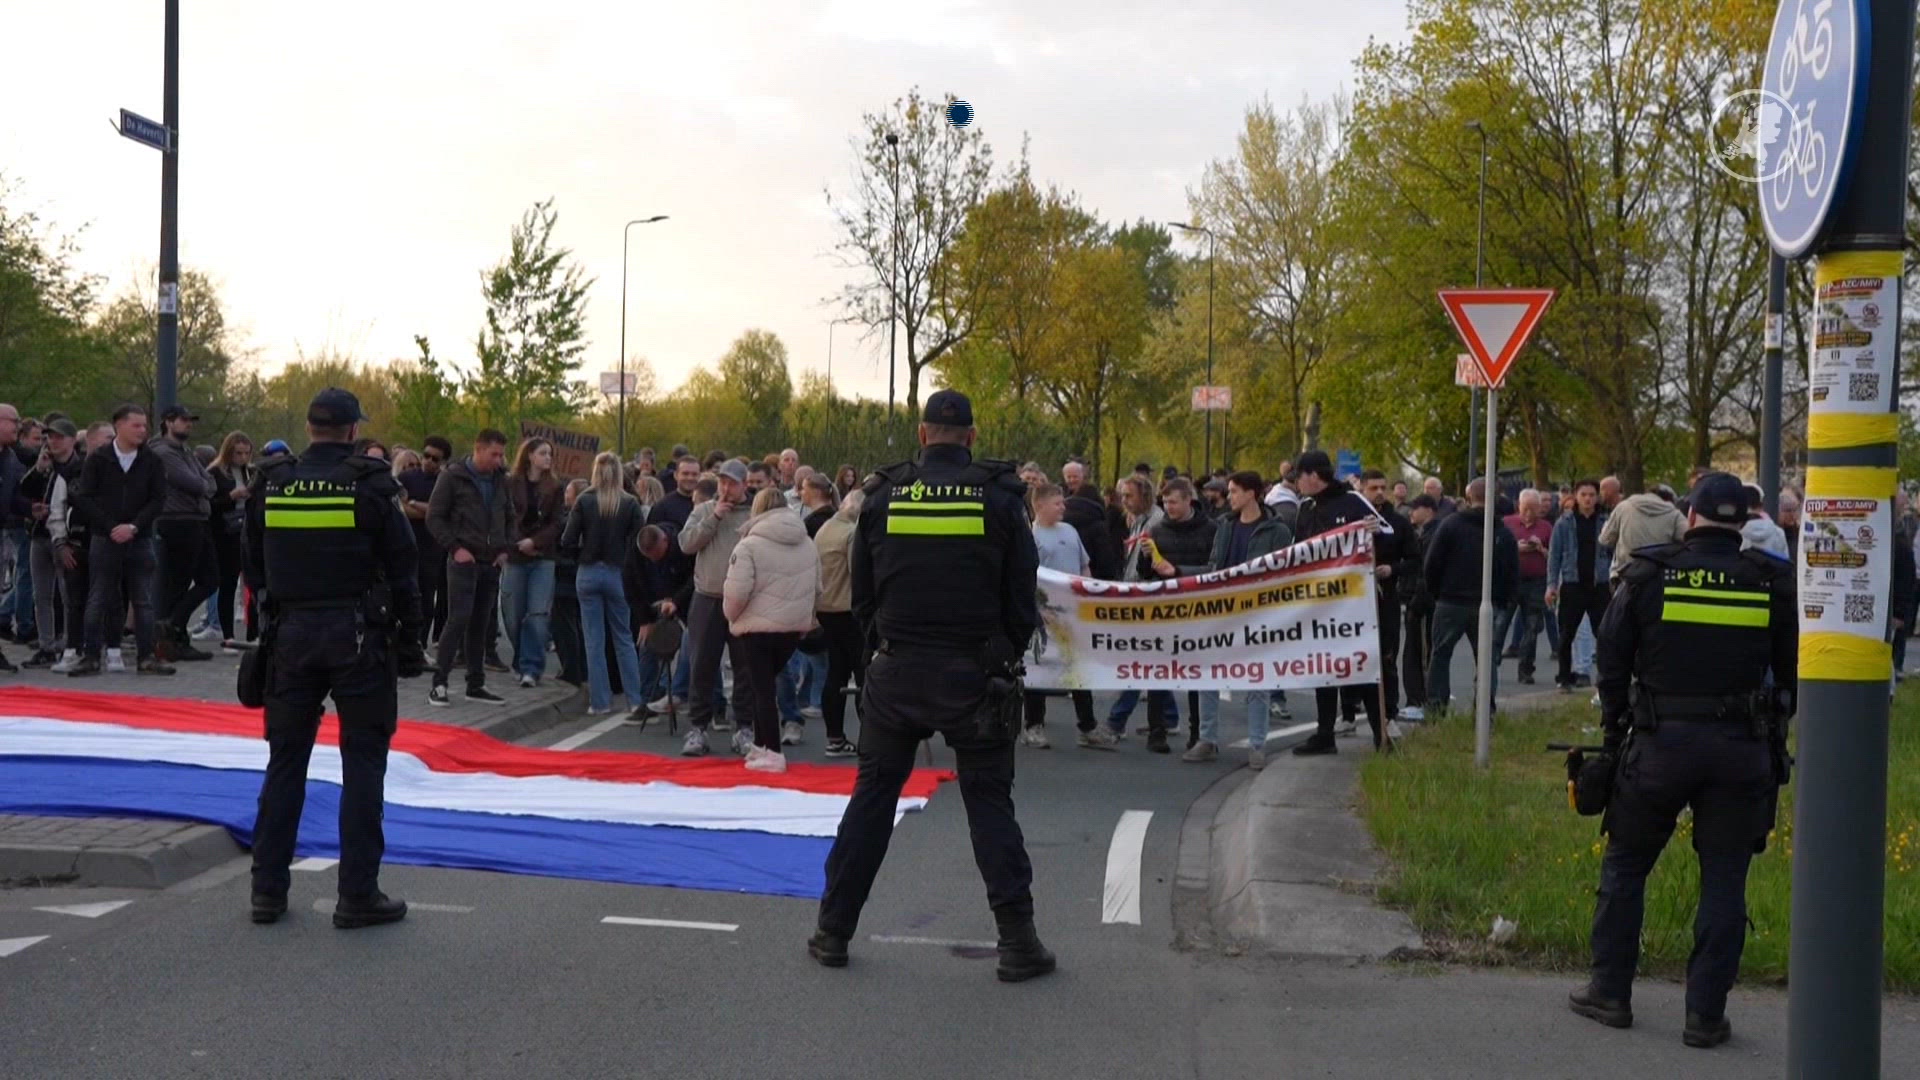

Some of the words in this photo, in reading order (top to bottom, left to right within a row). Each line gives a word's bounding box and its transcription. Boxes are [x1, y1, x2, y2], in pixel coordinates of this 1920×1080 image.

[126, 117, 135, 130] De
[901, 479, 972, 501] POLITIE
[1807, 500, 1828, 512] STOP
[1095, 606, 1145, 621] GEEN
[1151, 597, 1236, 620] AZC/AMV
[1257, 579, 1347, 606] ENGELEN!
[1091, 632, 1164, 652] Fietst
[1171, 631, 1235, 655] jouw
[1243, 621, 1302, 646] kind
[1312, 618, 1365, 640] hier
[1116, 659, 1202, 680] straks
[1211, 661, 1264, 684] nog
[1272, 651, 1368, 679] veilig?
